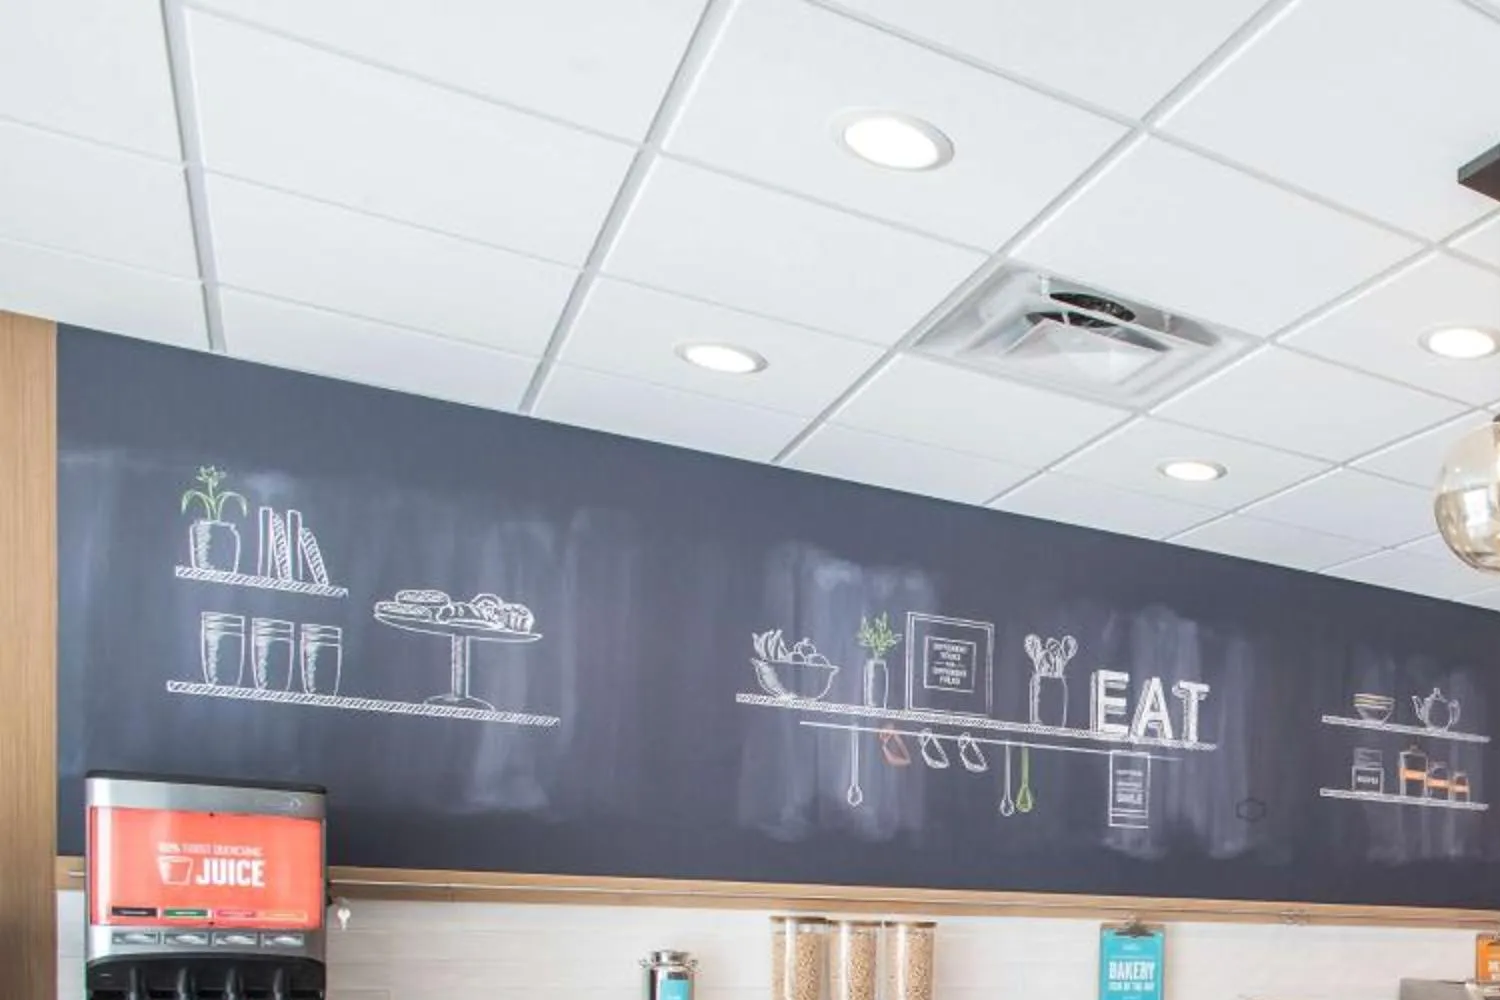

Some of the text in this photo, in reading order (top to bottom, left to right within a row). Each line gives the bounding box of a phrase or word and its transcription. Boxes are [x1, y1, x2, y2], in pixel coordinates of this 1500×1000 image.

[1090, 669, 1210, 743] EAT
[195, 857, 265, 888] JUICE
[1108, 960, 1155, 981] BAKERY
